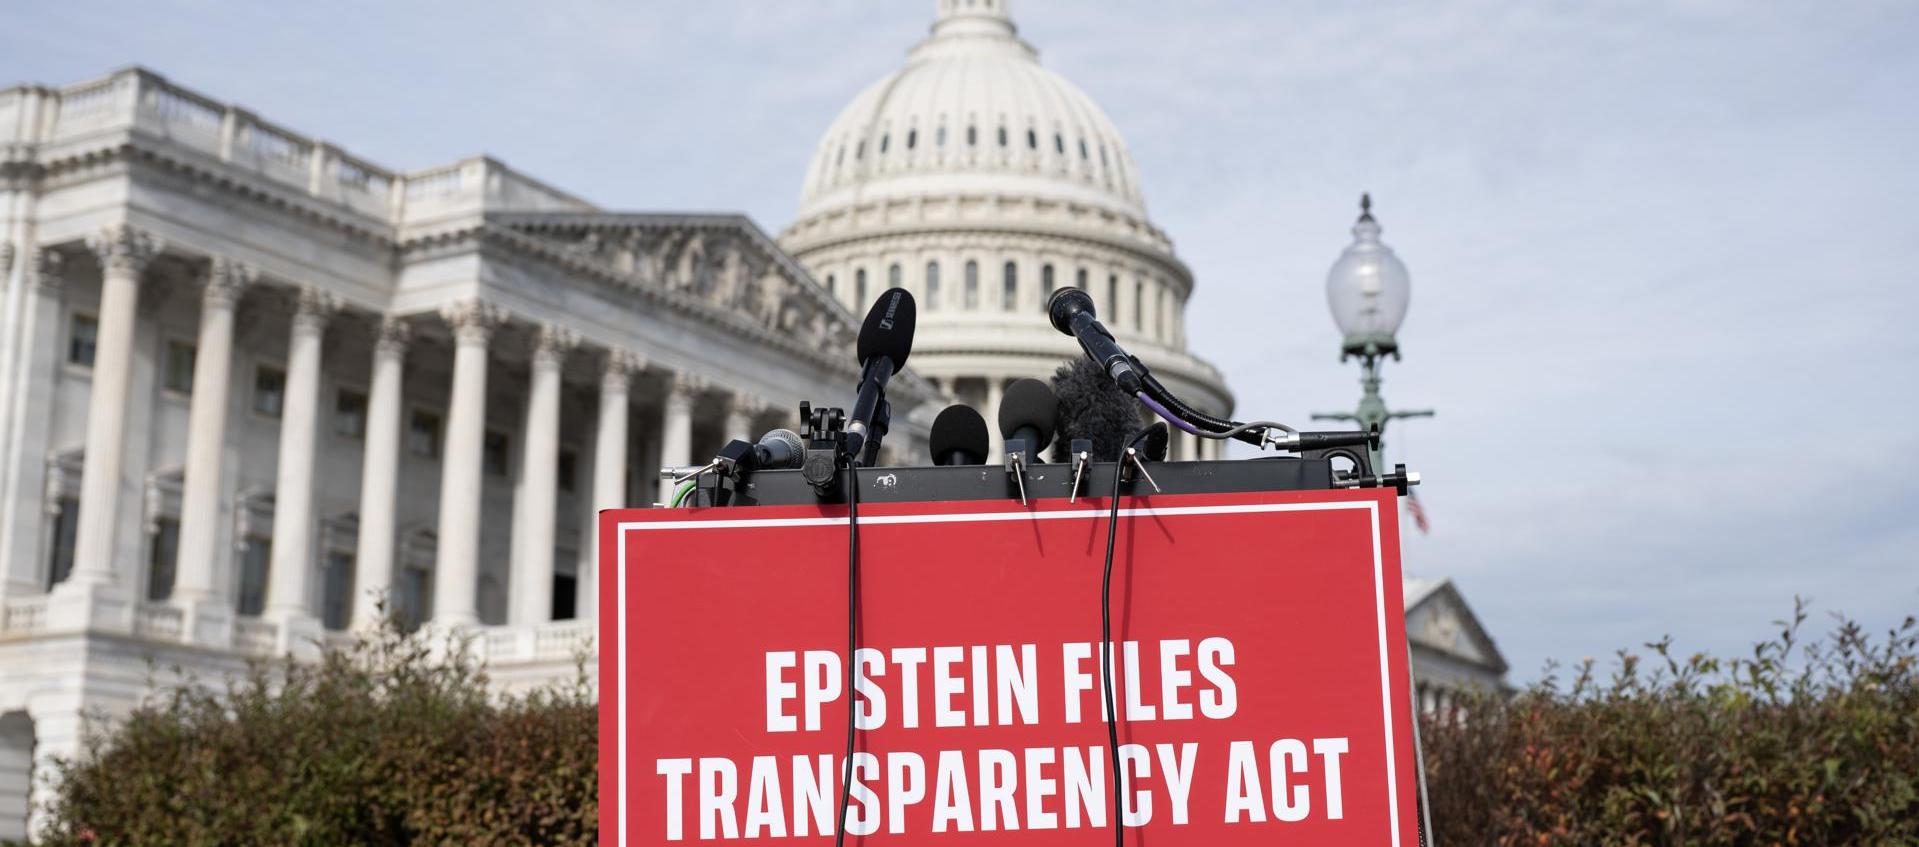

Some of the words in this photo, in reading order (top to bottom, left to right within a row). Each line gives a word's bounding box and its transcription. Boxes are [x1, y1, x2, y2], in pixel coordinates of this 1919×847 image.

[765, 643, 1039, 733] EPSTEIN
[1062, 636, 1238, 724] FILES
[656, 742, 1199, 841] TRANSPARENCY
[1224, 737, 1349, 823] ACT
